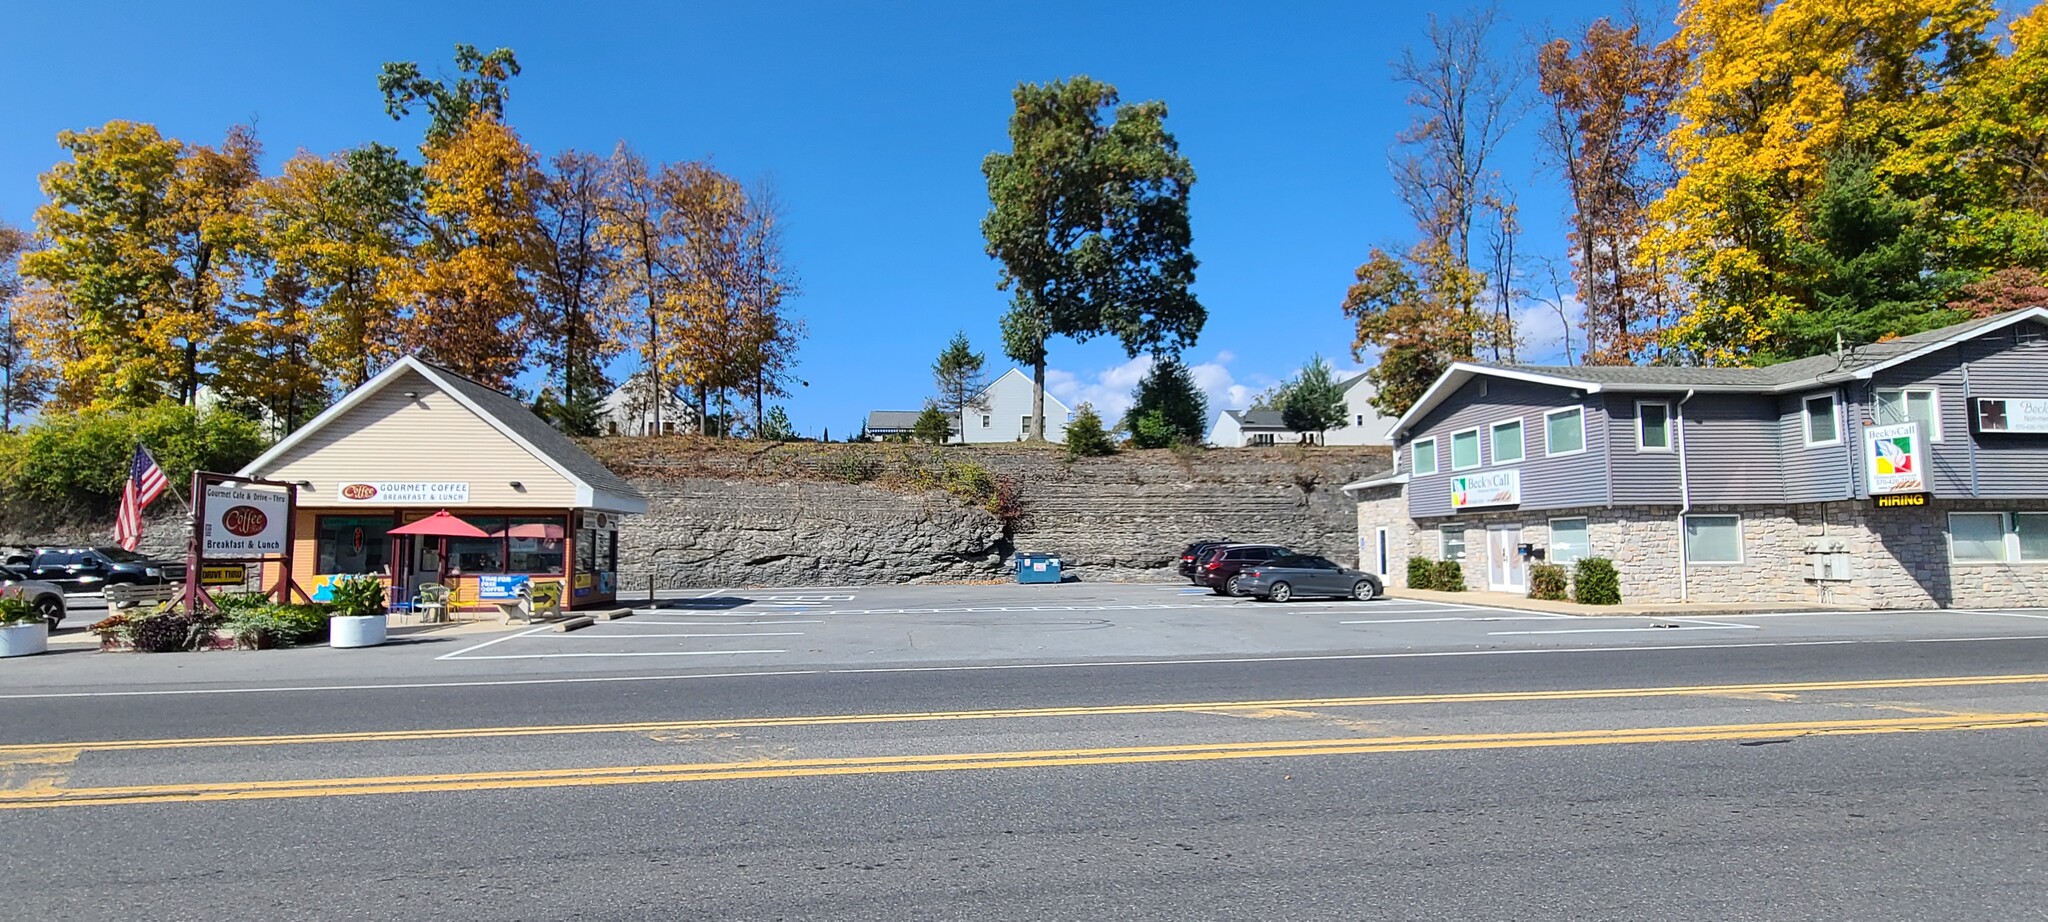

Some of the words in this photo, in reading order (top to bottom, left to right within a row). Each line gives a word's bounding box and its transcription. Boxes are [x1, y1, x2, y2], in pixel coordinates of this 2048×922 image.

[207, 488, 231, 498] Gourmet
[233, 491, 245, 500] Cafe
[344, 485, 374, 498] Coffee
[1879, 494, 1924, 507] HIRING
[226, 510, 262, 533] Coffee
[207, 540, 245, 549] Breakfast
[248, 540, 254, 548] &
[258, 540, 280, 549] Lunch
[202, 570, 222, 578] DRIVE
[225, 570, 242, 578] THRU
